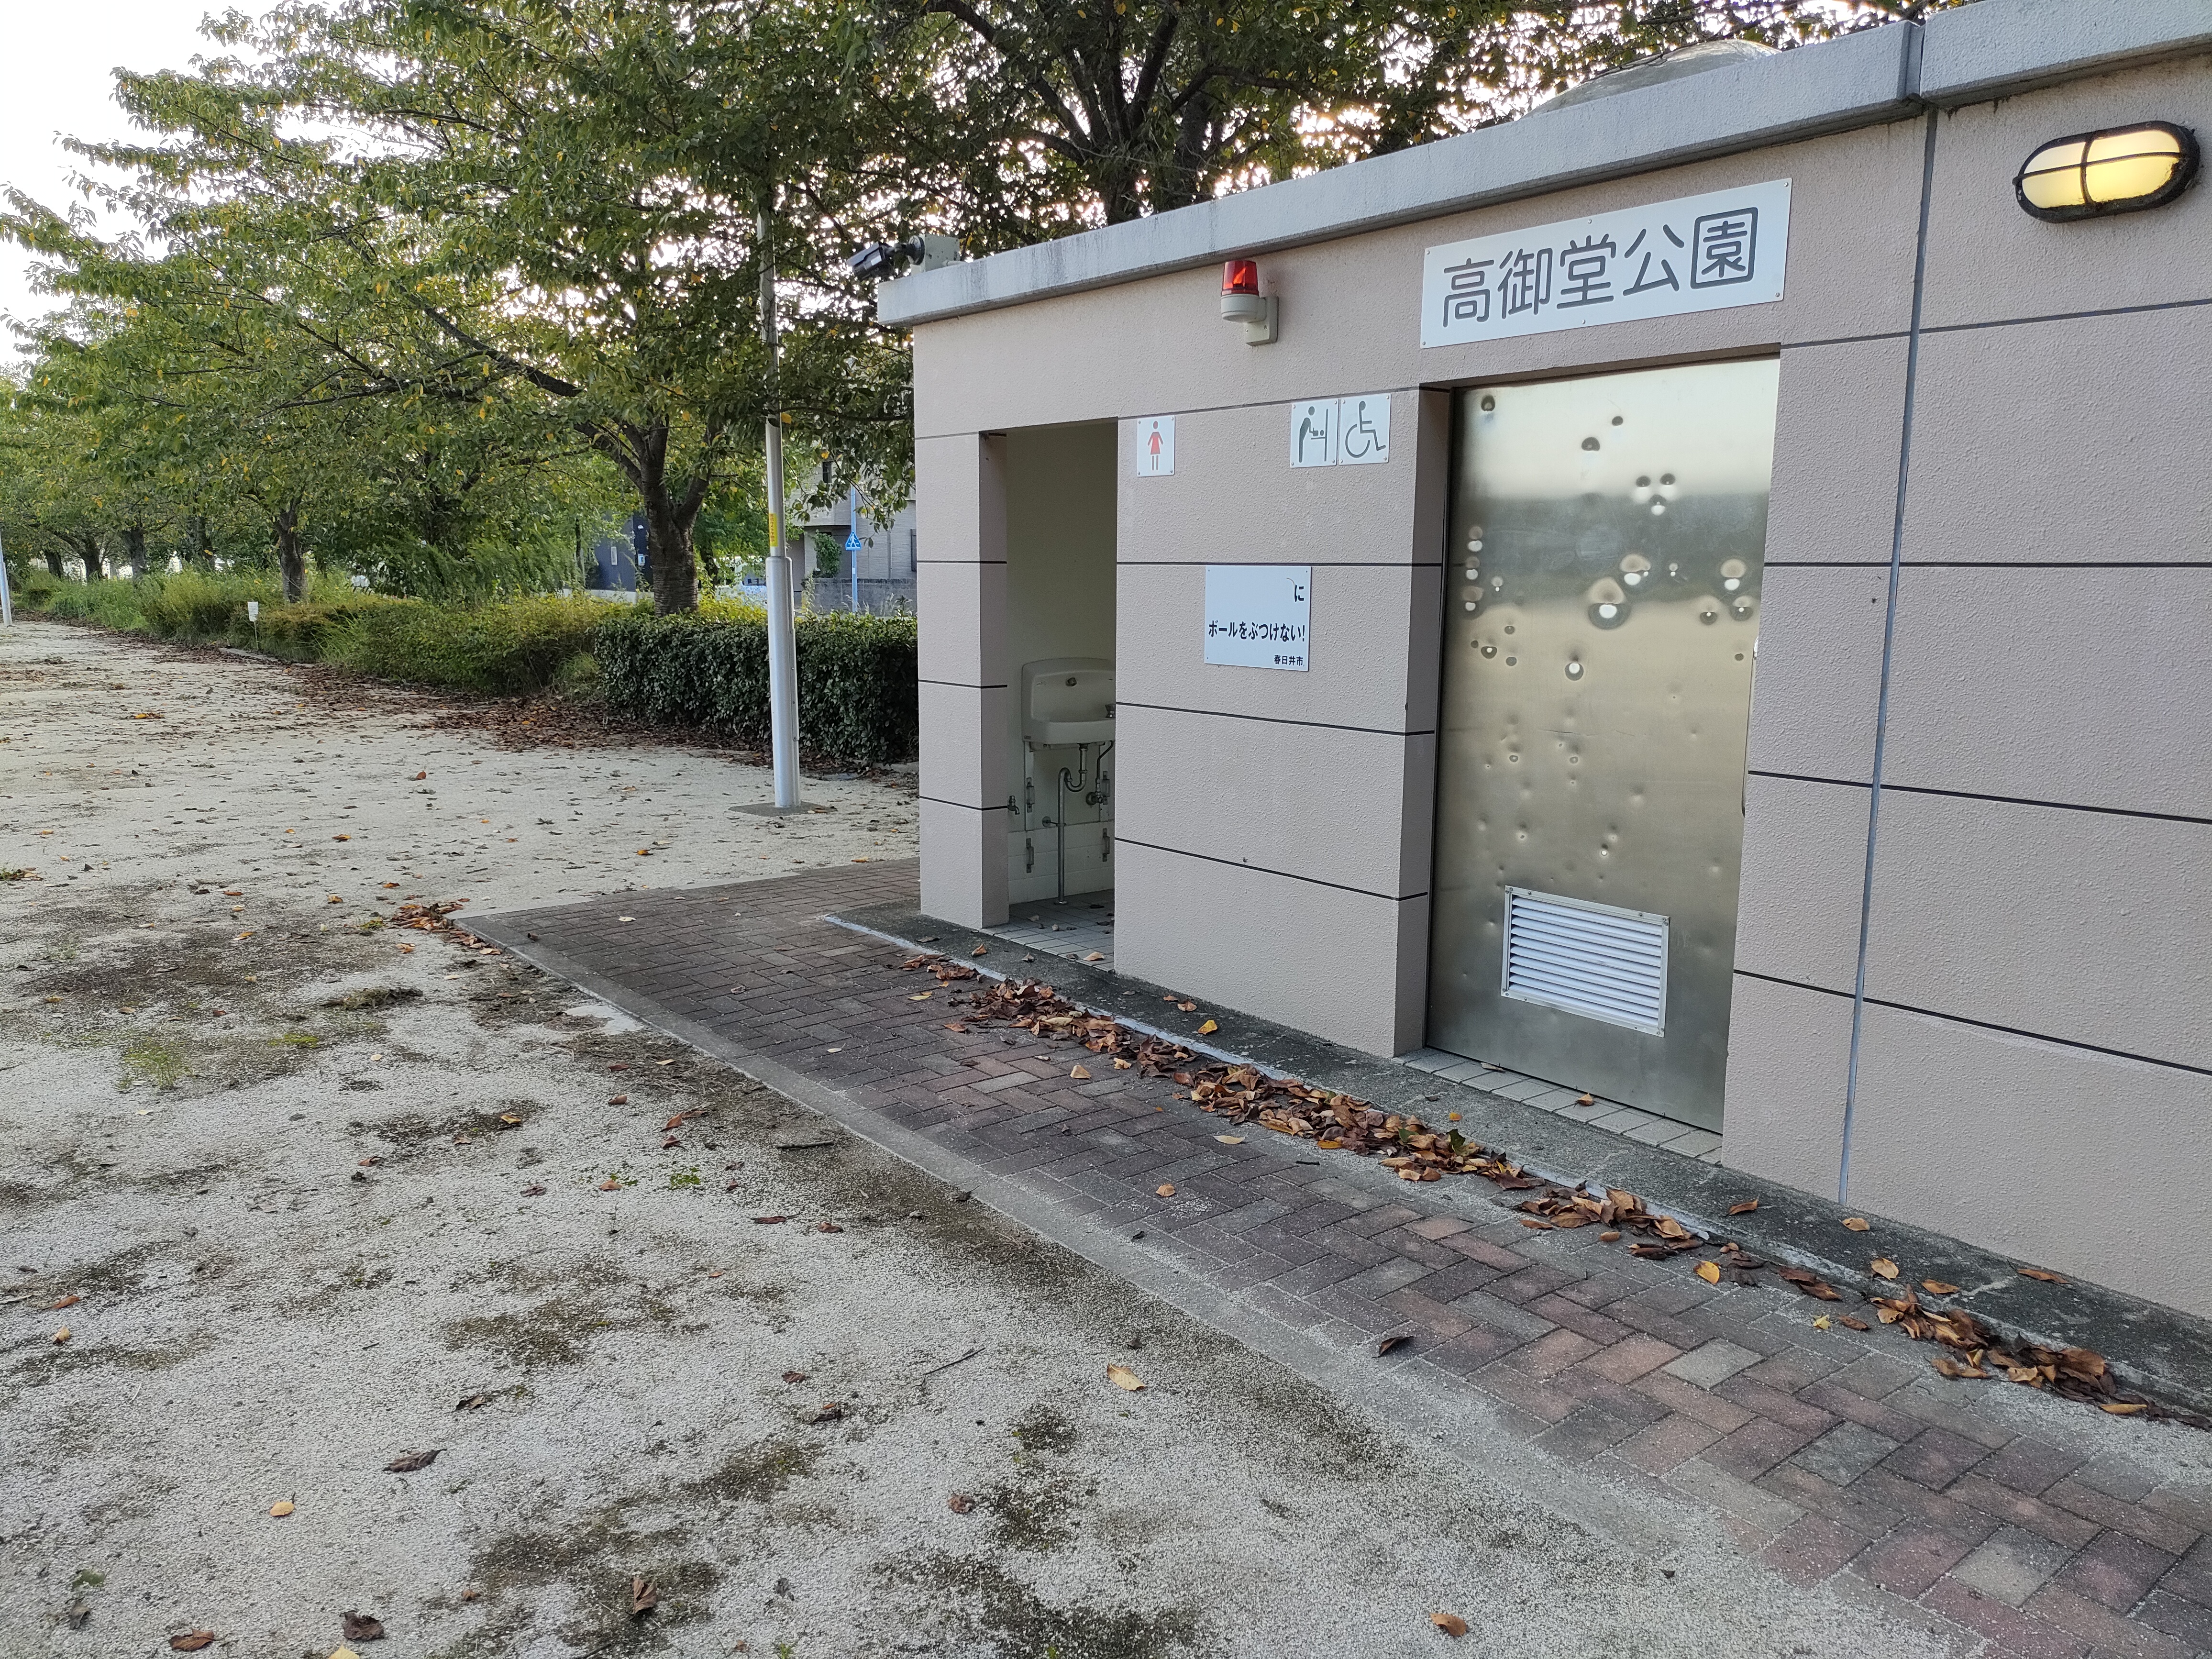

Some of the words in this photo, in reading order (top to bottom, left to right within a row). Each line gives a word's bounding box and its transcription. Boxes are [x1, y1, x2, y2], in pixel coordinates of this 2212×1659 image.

[1443, 207, 1759, 327] 高御堂公園
[1294, 584, 1304, 602] に
[1274, 655, 1304, 666] 春日井市
